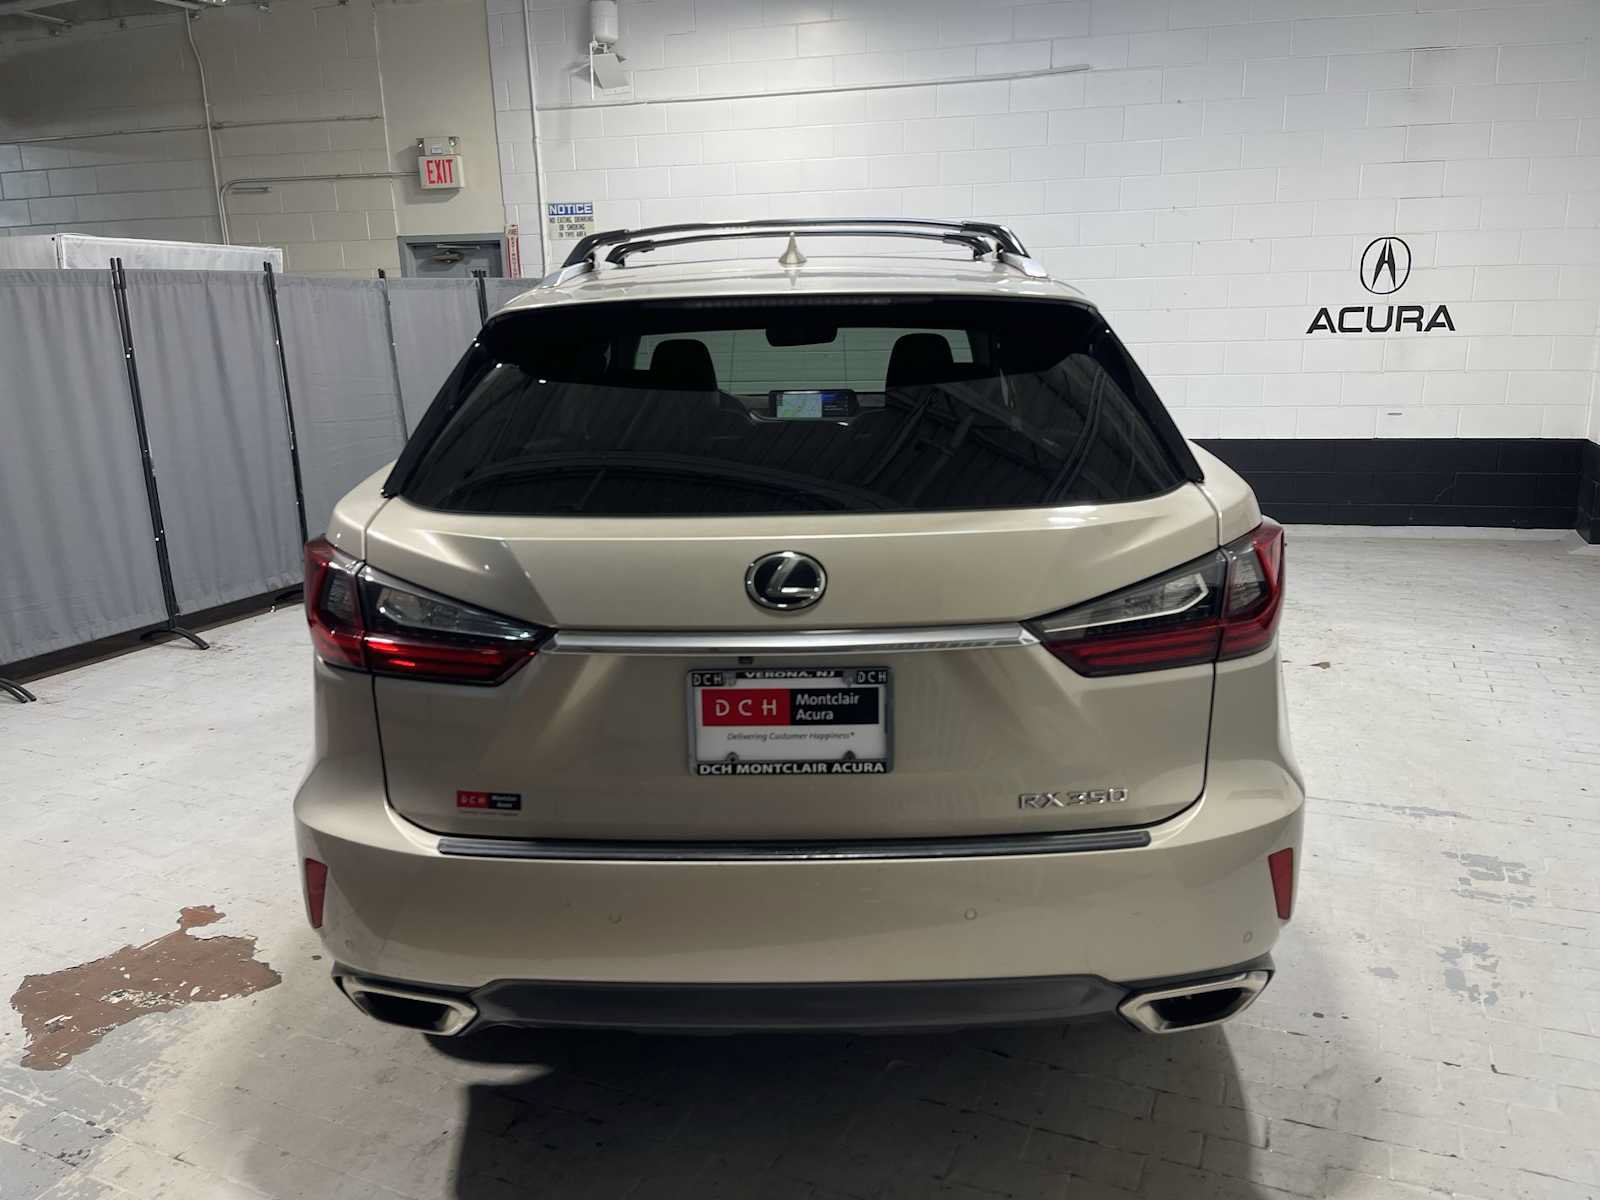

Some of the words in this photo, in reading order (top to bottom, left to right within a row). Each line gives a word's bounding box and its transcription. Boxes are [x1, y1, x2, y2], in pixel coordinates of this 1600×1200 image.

[426, 159, 453, 184] EXIT
[549, 203, 592, 215] NOTICE
[1306, 304, 1456, 334] ACURA
[692, 673, 723, 686] DCH
[816, 670, 836, 678] NJ
[857, 671, 887, 683] DCH
[796, 692, 860, 706] Montclair
[715, 698, 777, 717] DCH
[796, 709, 834, 721] Acura
[727, 732, 768, 742] Delivering
[769, 732, 807, 741] Customer
[700, 764, 732, 775] DCH
[736, 762, 828, 774] MONTCLAIR
[832, 762, 885, 774] ACURA
[1018, 791, 1064, 809] RX
[1066, 787, 1129, 805] 350
